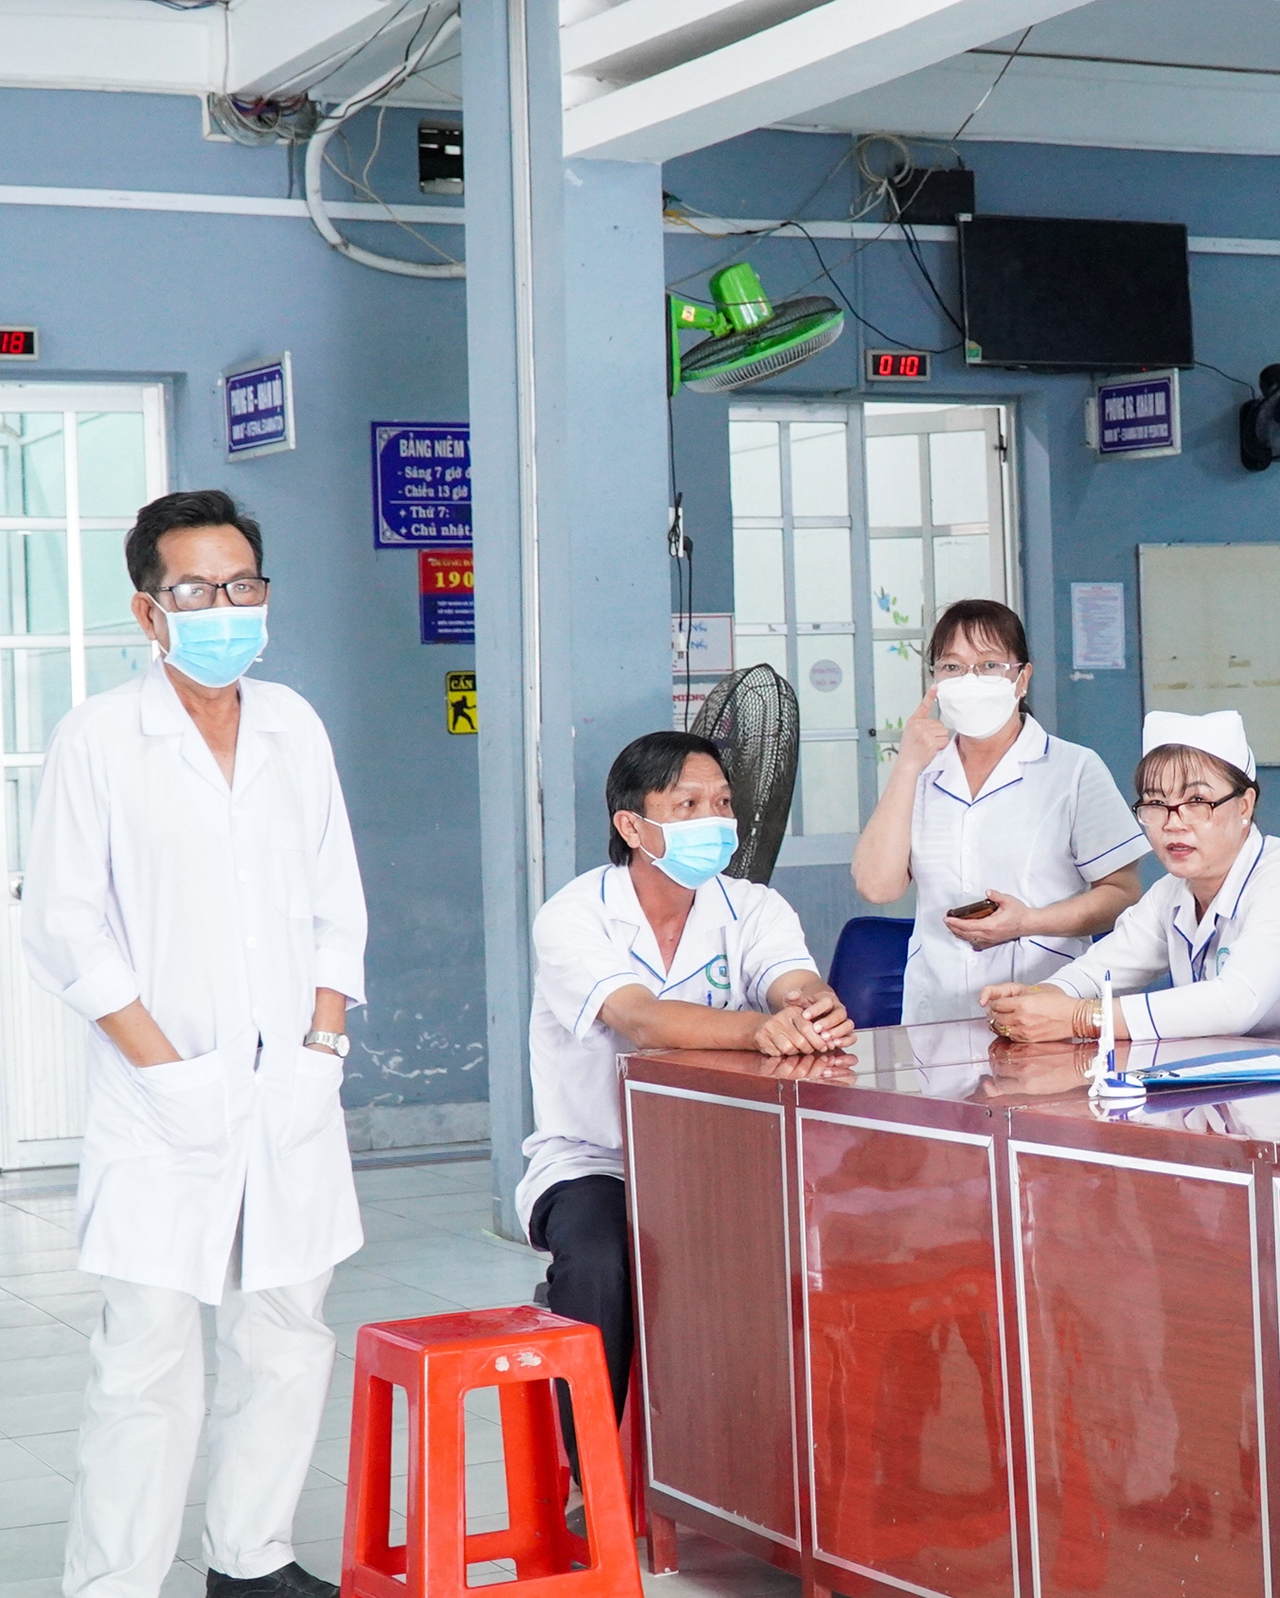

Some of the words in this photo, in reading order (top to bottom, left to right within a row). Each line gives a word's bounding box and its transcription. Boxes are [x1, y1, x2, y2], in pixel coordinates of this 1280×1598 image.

[400, 432, 432, 458] BẢNG
[434, 466, 442, 478] 7
[438, 486, 450, 498] 13
[438, 506, 450, 518] 7:
